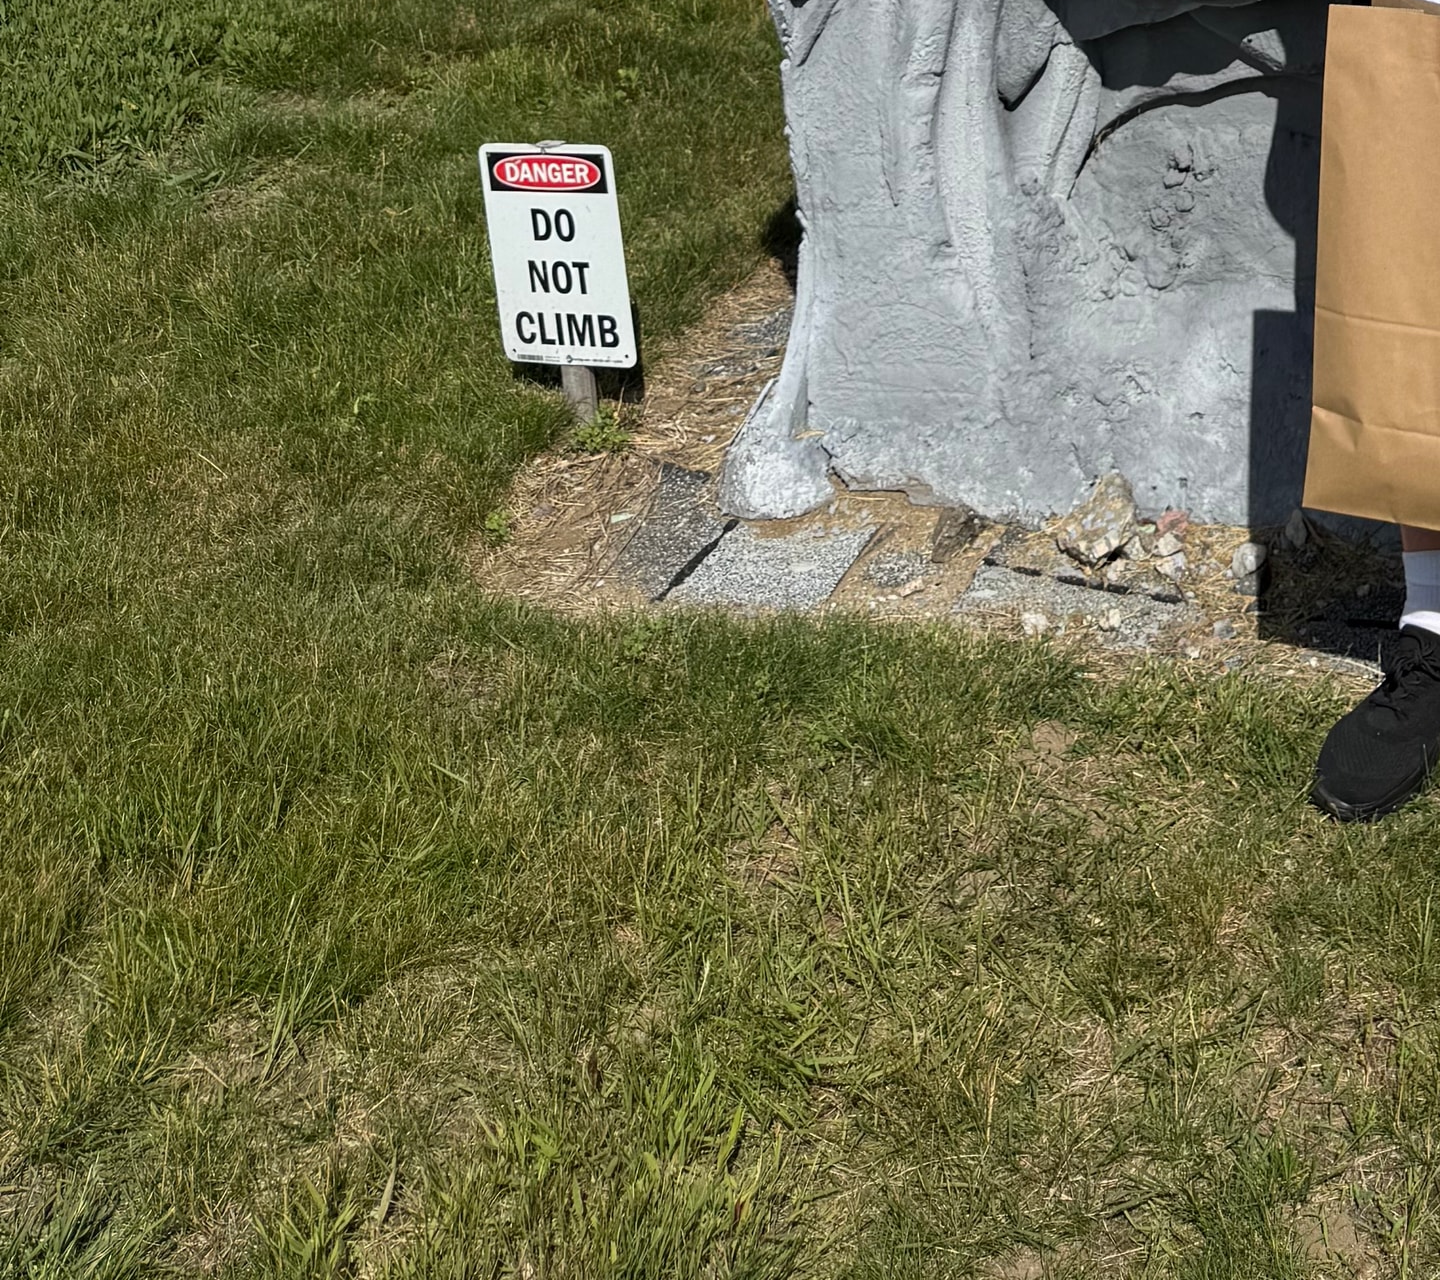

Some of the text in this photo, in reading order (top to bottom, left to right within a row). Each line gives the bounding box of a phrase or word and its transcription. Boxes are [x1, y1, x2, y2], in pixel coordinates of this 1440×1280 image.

[504, 161, 590, 184] DANGER
[530, 208, 575, 243] DO
[527, 259, 590, 295] NOT
[515, 310, 620, 349] CLIMB
